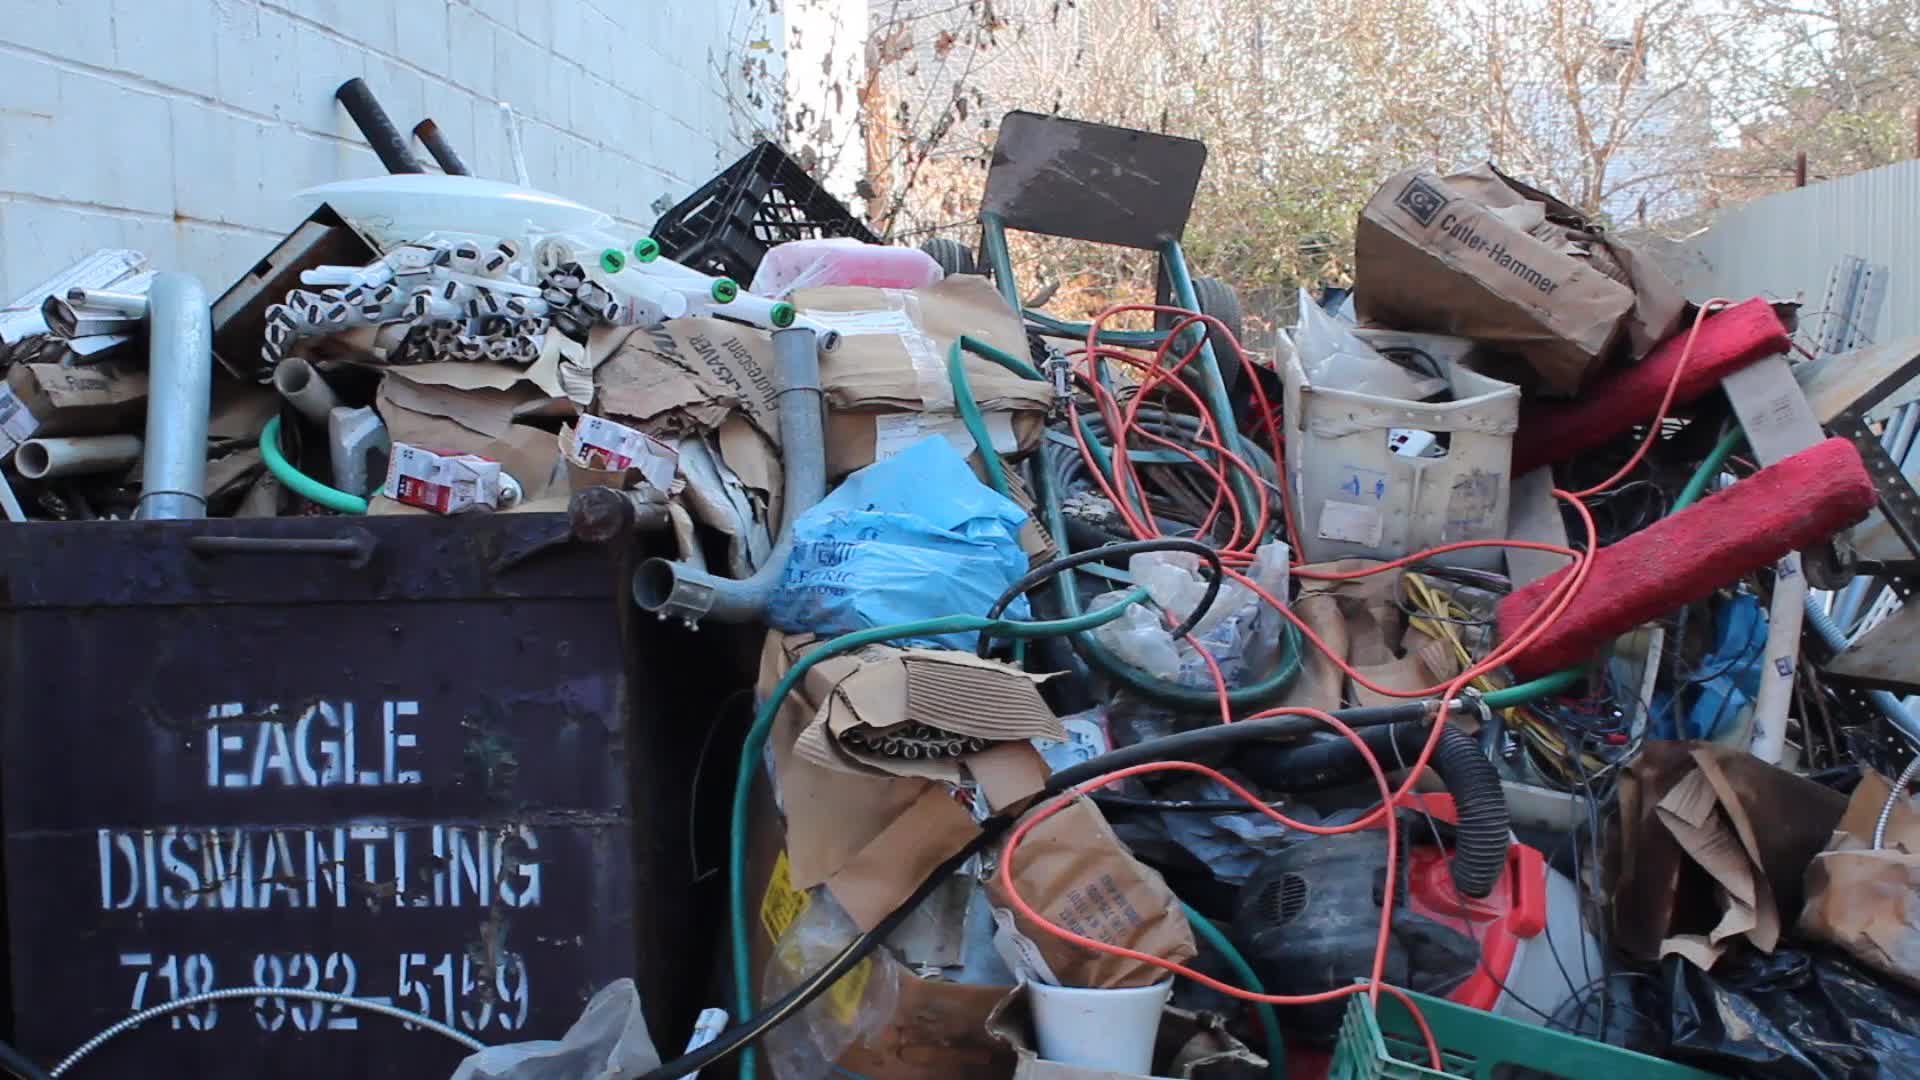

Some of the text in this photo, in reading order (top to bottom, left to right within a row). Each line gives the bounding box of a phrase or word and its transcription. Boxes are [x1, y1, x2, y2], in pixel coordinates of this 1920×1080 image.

[1441, 214, 1559, 295] Cutler-Hammer
[722, 337, 779, 411] Fluorescent
[207, 701, 422, 787] EAGLE
[98, 823, 541, 908] DISMANTLING
[120, 953, 217, 1031] 718
